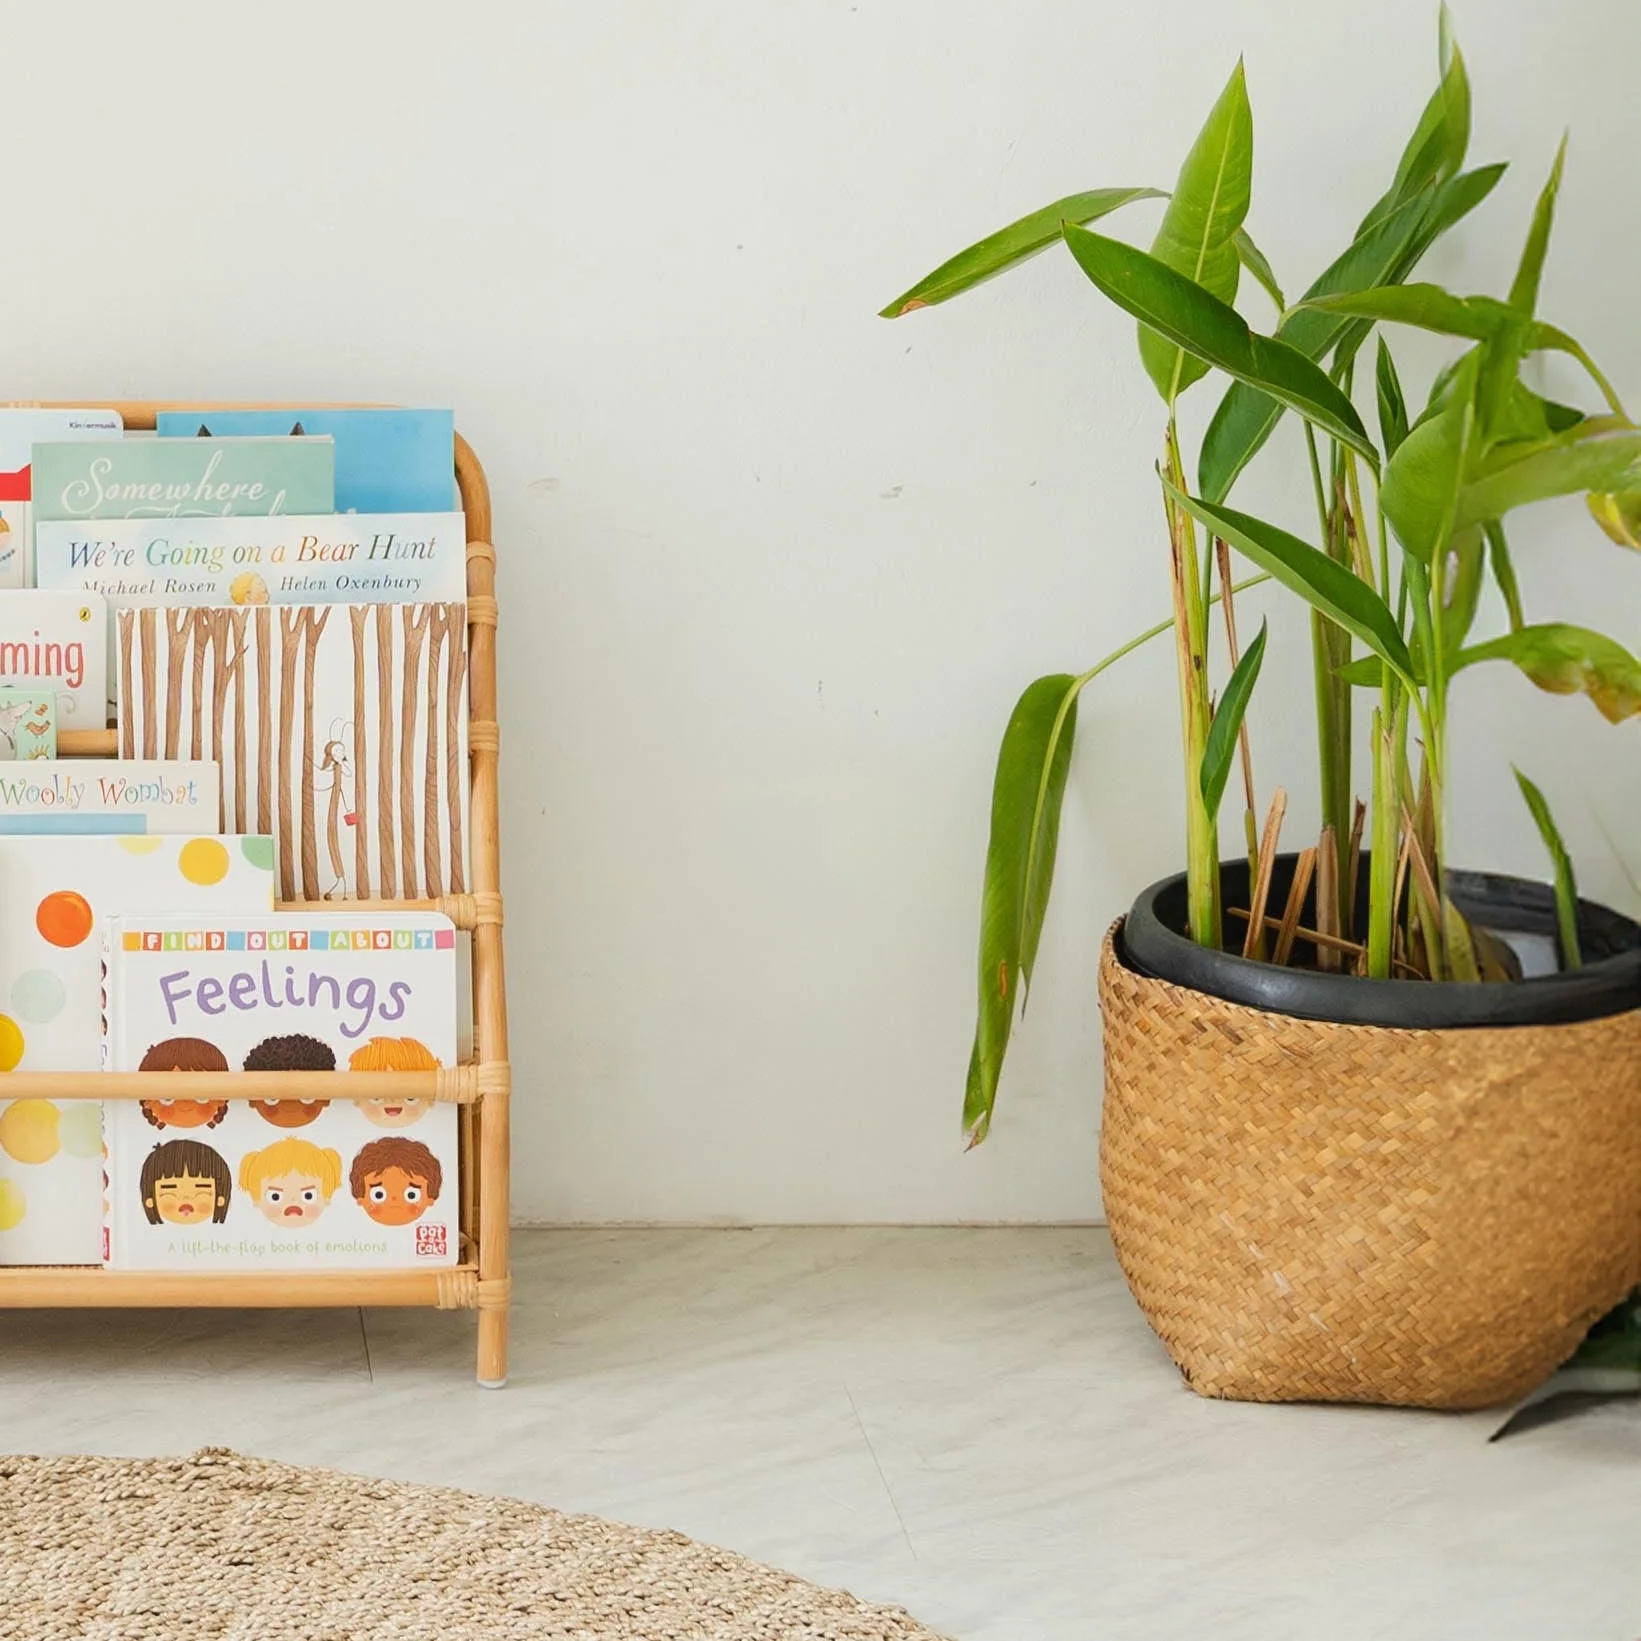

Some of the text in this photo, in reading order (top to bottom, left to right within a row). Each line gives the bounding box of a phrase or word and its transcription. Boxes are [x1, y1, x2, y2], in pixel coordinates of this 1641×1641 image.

[69, 421, 116, 429] Kinermusik
[62, 449, 266, 515] Somewhere
[69, 534, 436, 573] We're Going on a Bear Hunt
[83, 574, 422, 595] Michael Rosen Helen Oxenbury
[98, 776, 199, 806] Wombat
[146, 932, 432, 950] FIND OUT ABOUT
[160, 960, 412, 1039] Feelings
[168, 1243, 176, 1253] A
[271, 1239, 299, 1252] book
[306, 1240, 319, 1255] of
[326, 1239, 388, 1252] emotions
